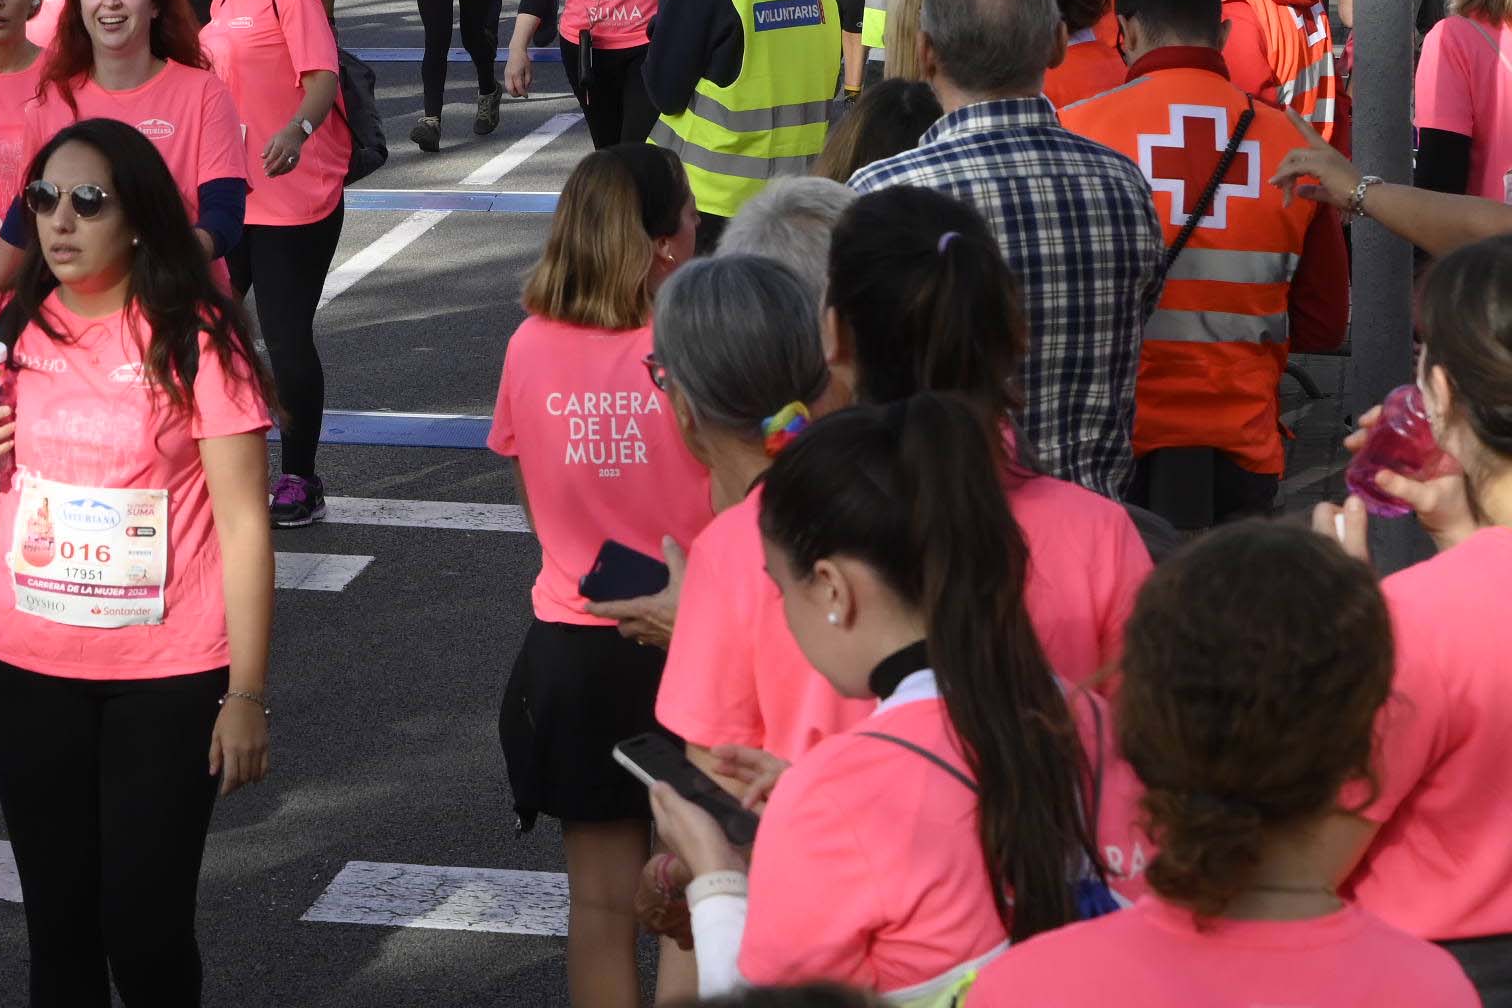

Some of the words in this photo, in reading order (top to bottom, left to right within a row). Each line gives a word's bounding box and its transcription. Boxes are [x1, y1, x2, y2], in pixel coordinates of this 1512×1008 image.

[589, 4, 643, 22] SUMA
[755, 4, 820, 24] VOLUNTARIS
[546, 391, 663, 416] CARRERA
[568, 417, 601, 441] DE
[610, 416, 643, 439] LA
[564, 441, 649, 465] MUJER
[598, 468, 621, 478] 2023
[63, 509, 120, 526] ASTURIANA
[127, 507, 155, 517] SUMA
[59, 541, 111, 563] 016
[65, 567, 104, 581] 17951
[27, 577, 65, 592] CARRERA
[66, 583, 79, 593] DE
[80, 585, 92, 595] LA
[92, 586, 125, 597] MUJER
[102, 606, 152, 617] Santander
